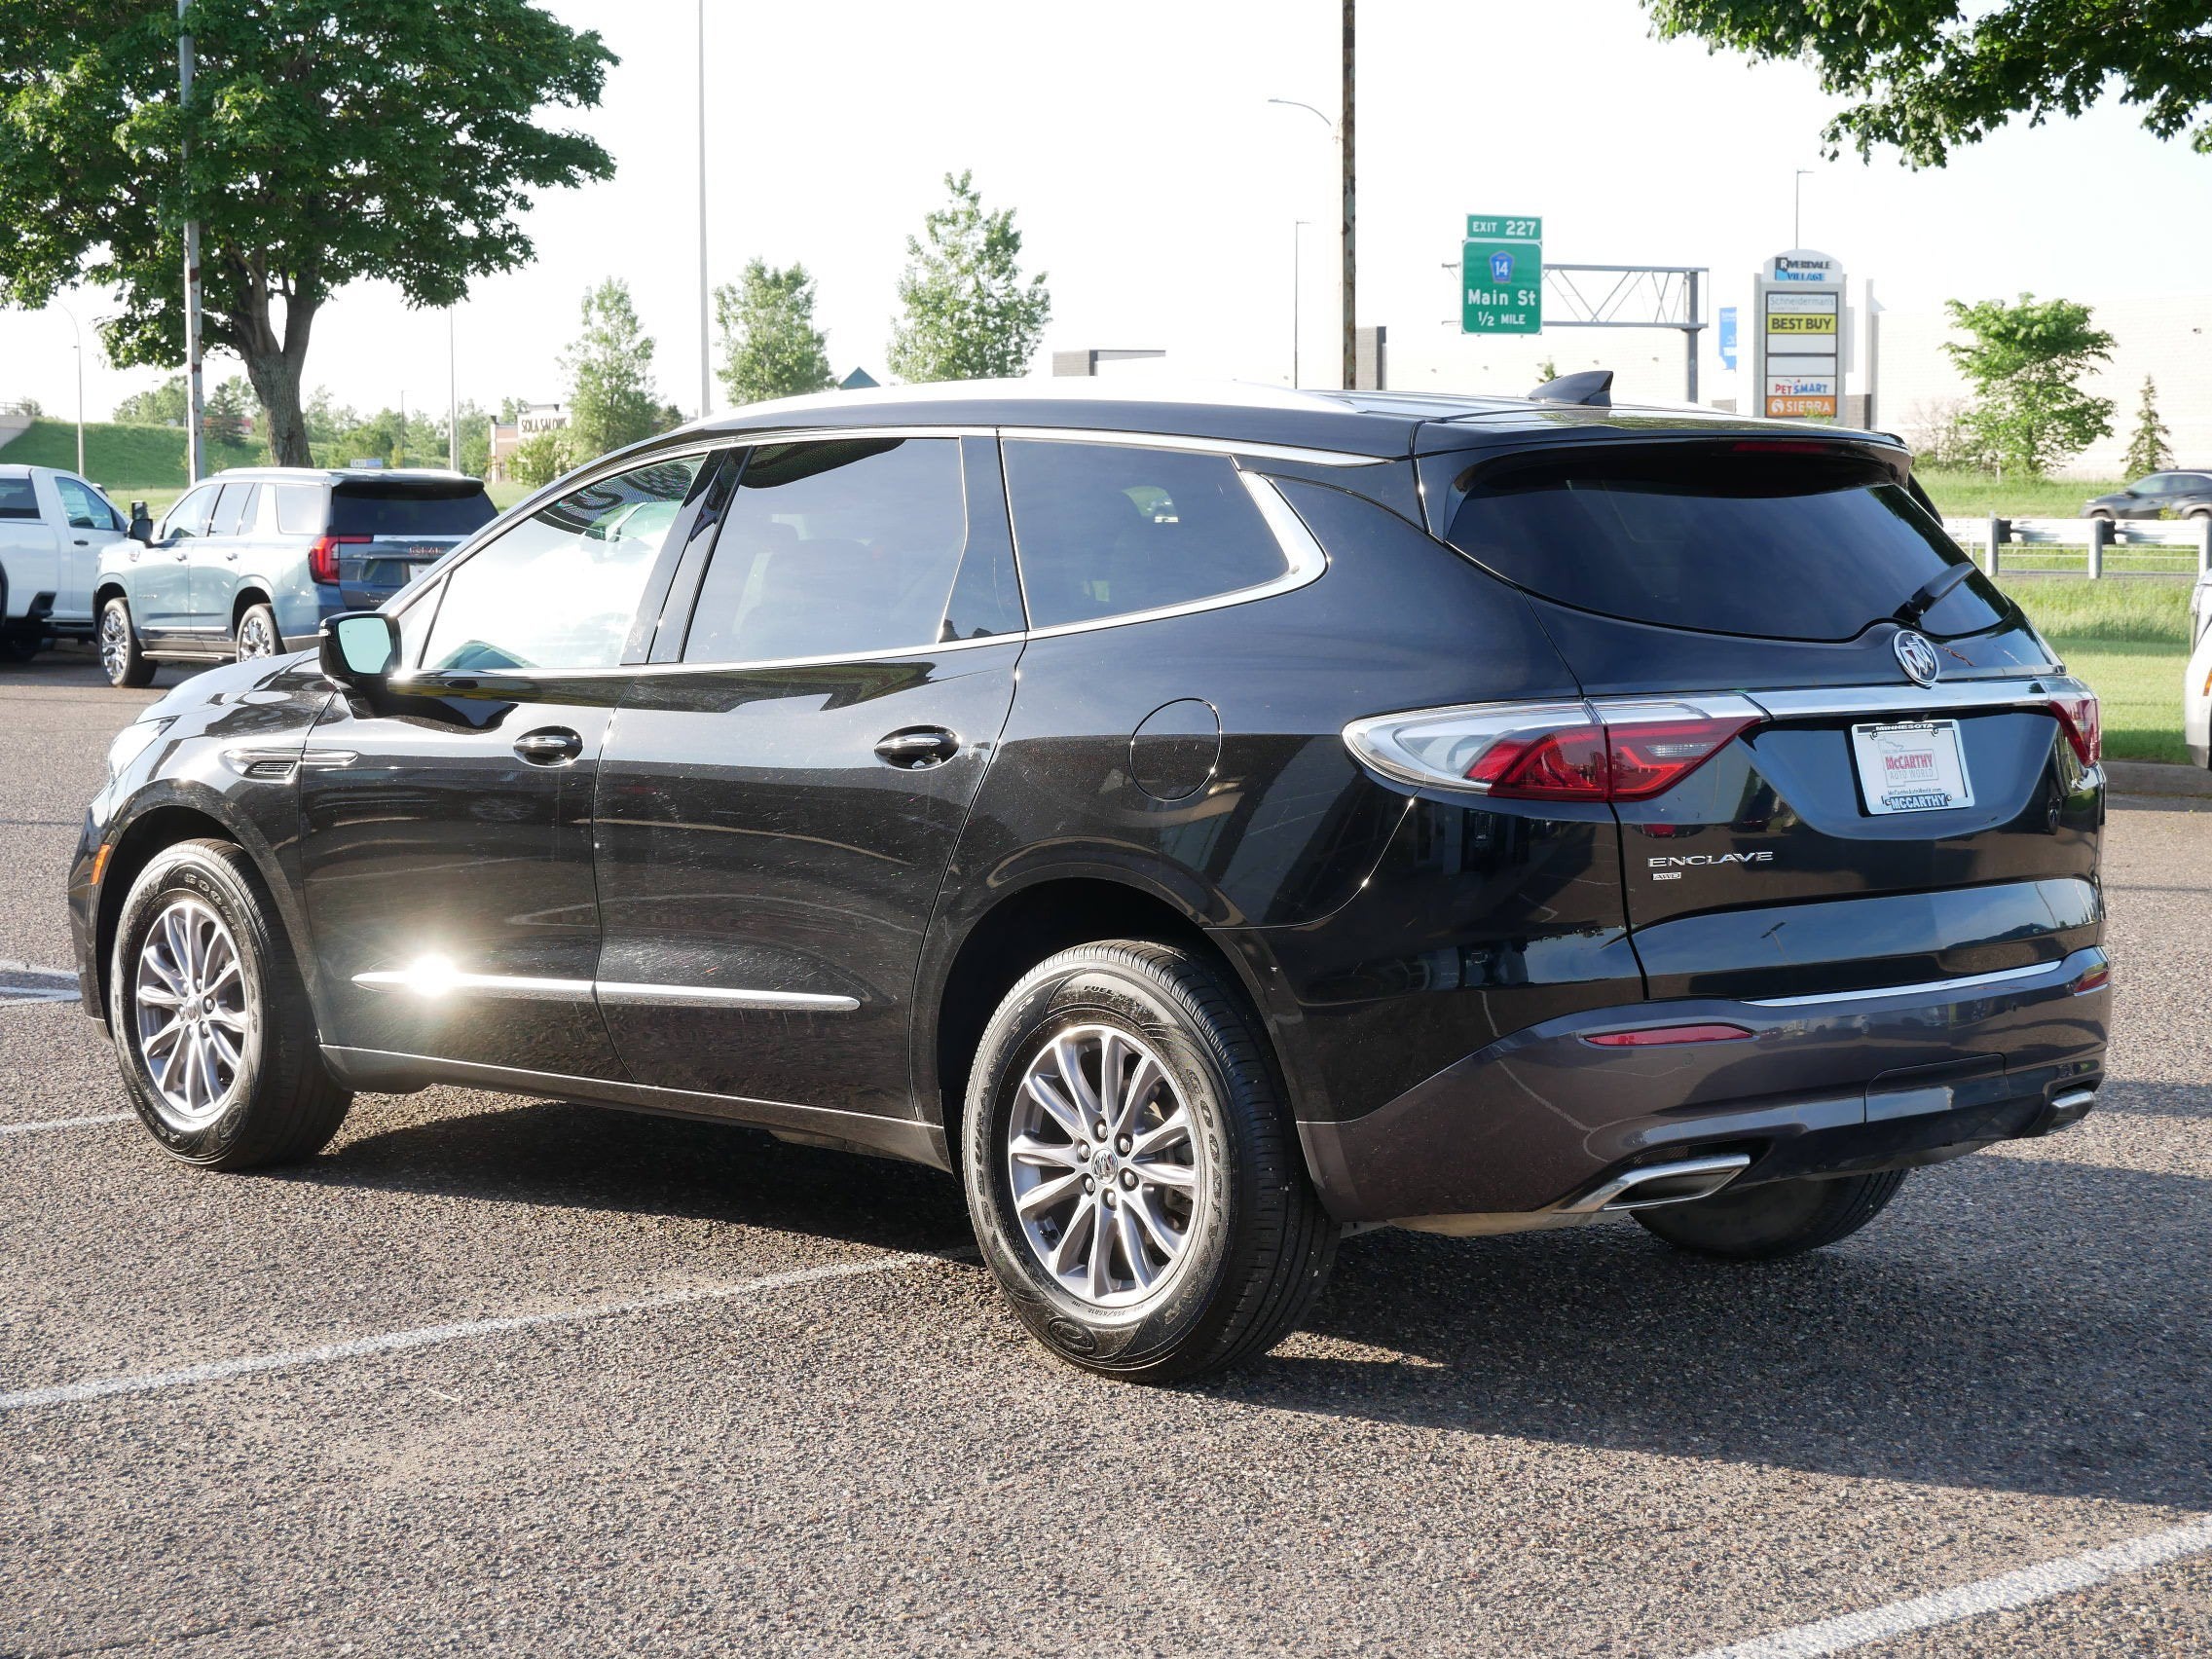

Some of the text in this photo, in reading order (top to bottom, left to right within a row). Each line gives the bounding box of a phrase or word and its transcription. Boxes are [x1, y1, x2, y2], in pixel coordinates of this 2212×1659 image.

[1472, 220, 1536, 237] EXIT 227
[1494, 261, 1508, 276] 14
[1467, 289, 1536, 307] Main St
[1500, 314, 1526, 325] MILE
[1771, 317, 1831, 331] BEST BUY
[1786, 401, 1831, 413] SIERRA
[1890, 768, 1934, 780] AUTO WORLD
[1647, 851, 1774, 867] ENCLAVE
